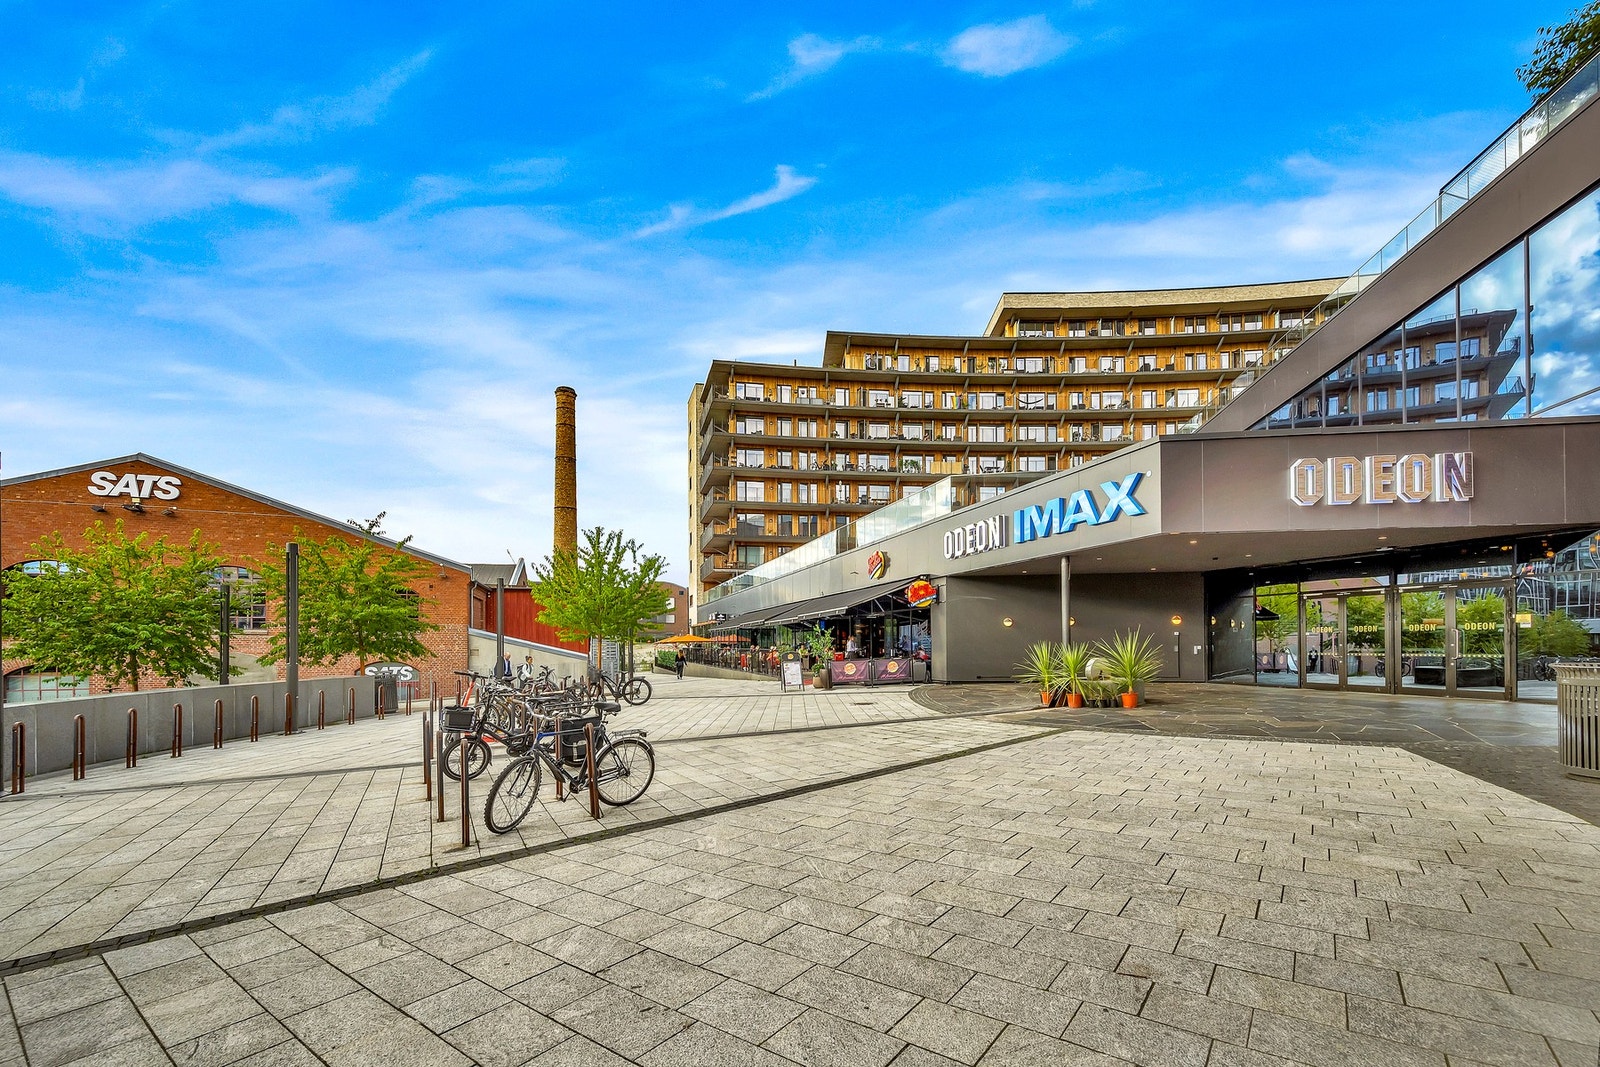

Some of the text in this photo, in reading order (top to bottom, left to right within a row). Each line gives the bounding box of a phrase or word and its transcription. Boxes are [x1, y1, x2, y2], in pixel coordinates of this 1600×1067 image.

[87, 471, 182, 500] SATS
[1290, 452, 1474, 506] ODEON
[943, 472, 1147, 559] ODEON IMAX
[1353, 625, 1378, 633] ODEON
[1408, 624, 1436, 632] ODEON
[1464, 622, 1496, 631] ODEON
